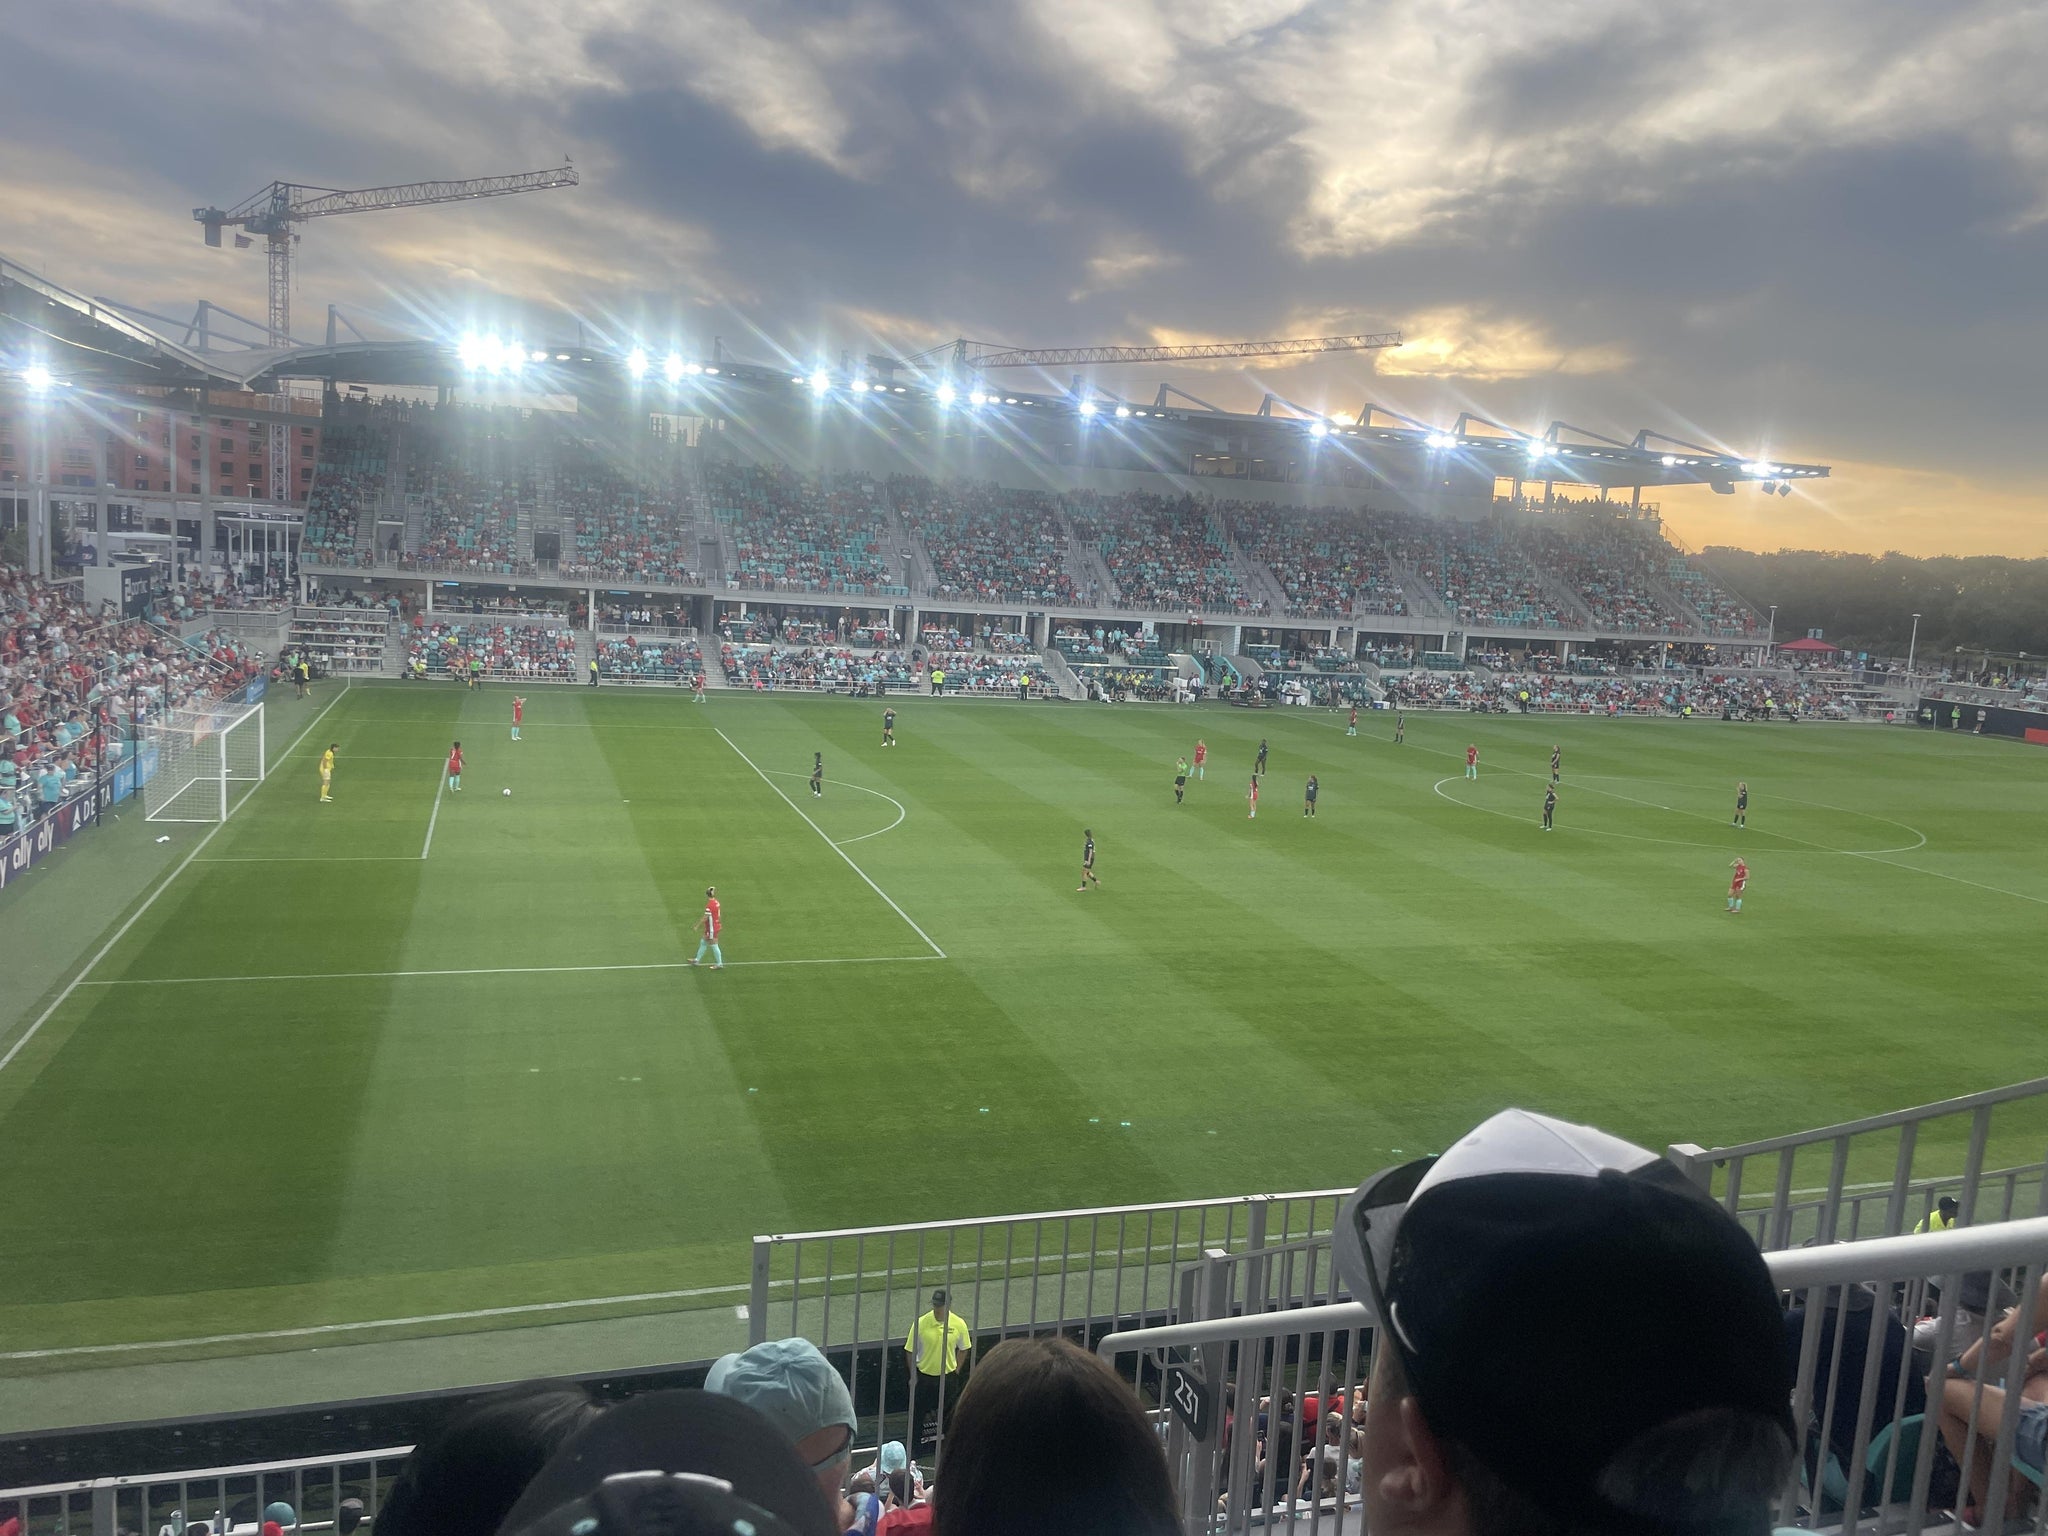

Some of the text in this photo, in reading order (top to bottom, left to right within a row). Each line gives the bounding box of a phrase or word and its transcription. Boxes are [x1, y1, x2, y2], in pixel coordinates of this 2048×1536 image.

[83, 784, 111, 821] DETA
[12, 834, 33, 870] ally
[37, 819, 55, 852] ally
[1174, 1371, 1199, 1424] 237
